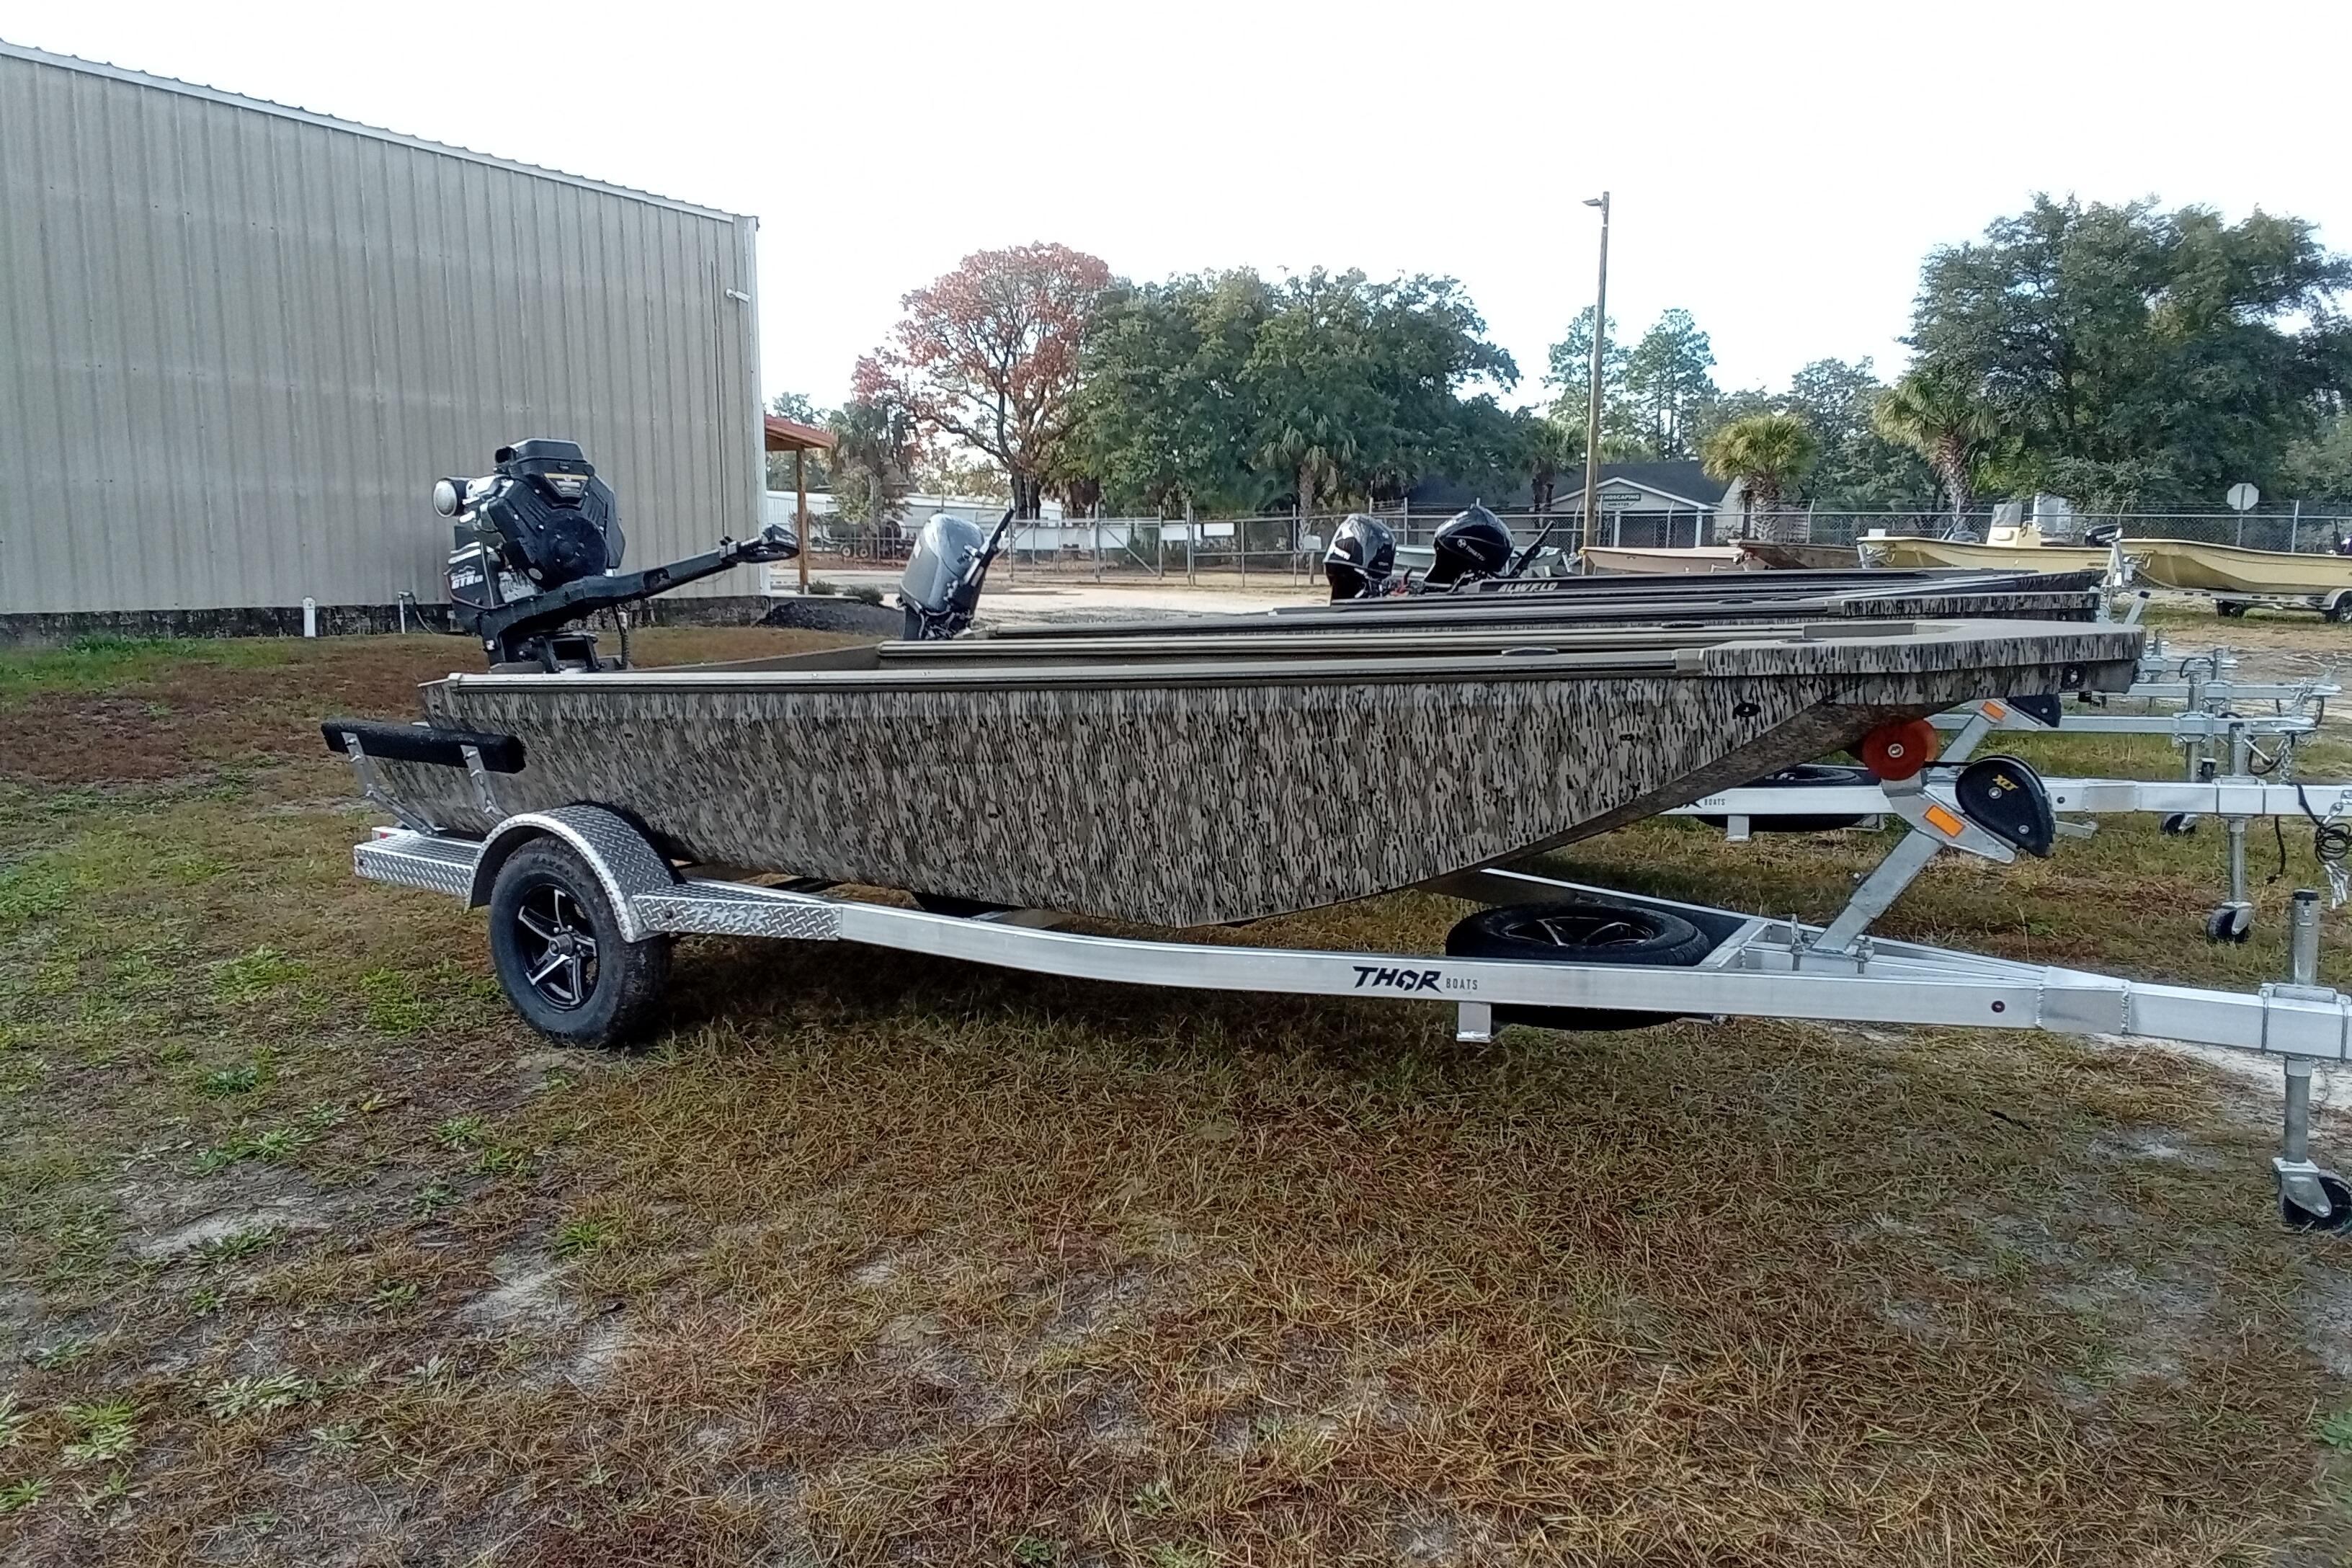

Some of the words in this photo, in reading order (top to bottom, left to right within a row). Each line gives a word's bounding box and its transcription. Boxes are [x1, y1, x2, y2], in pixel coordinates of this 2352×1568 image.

[1497, 582, 1558, 593] ALWELD
[689, 905, 767, 930] THOR
[1353, 966, 1443, 994] THOR
[1446, 978, 1478, 990] BOATS
